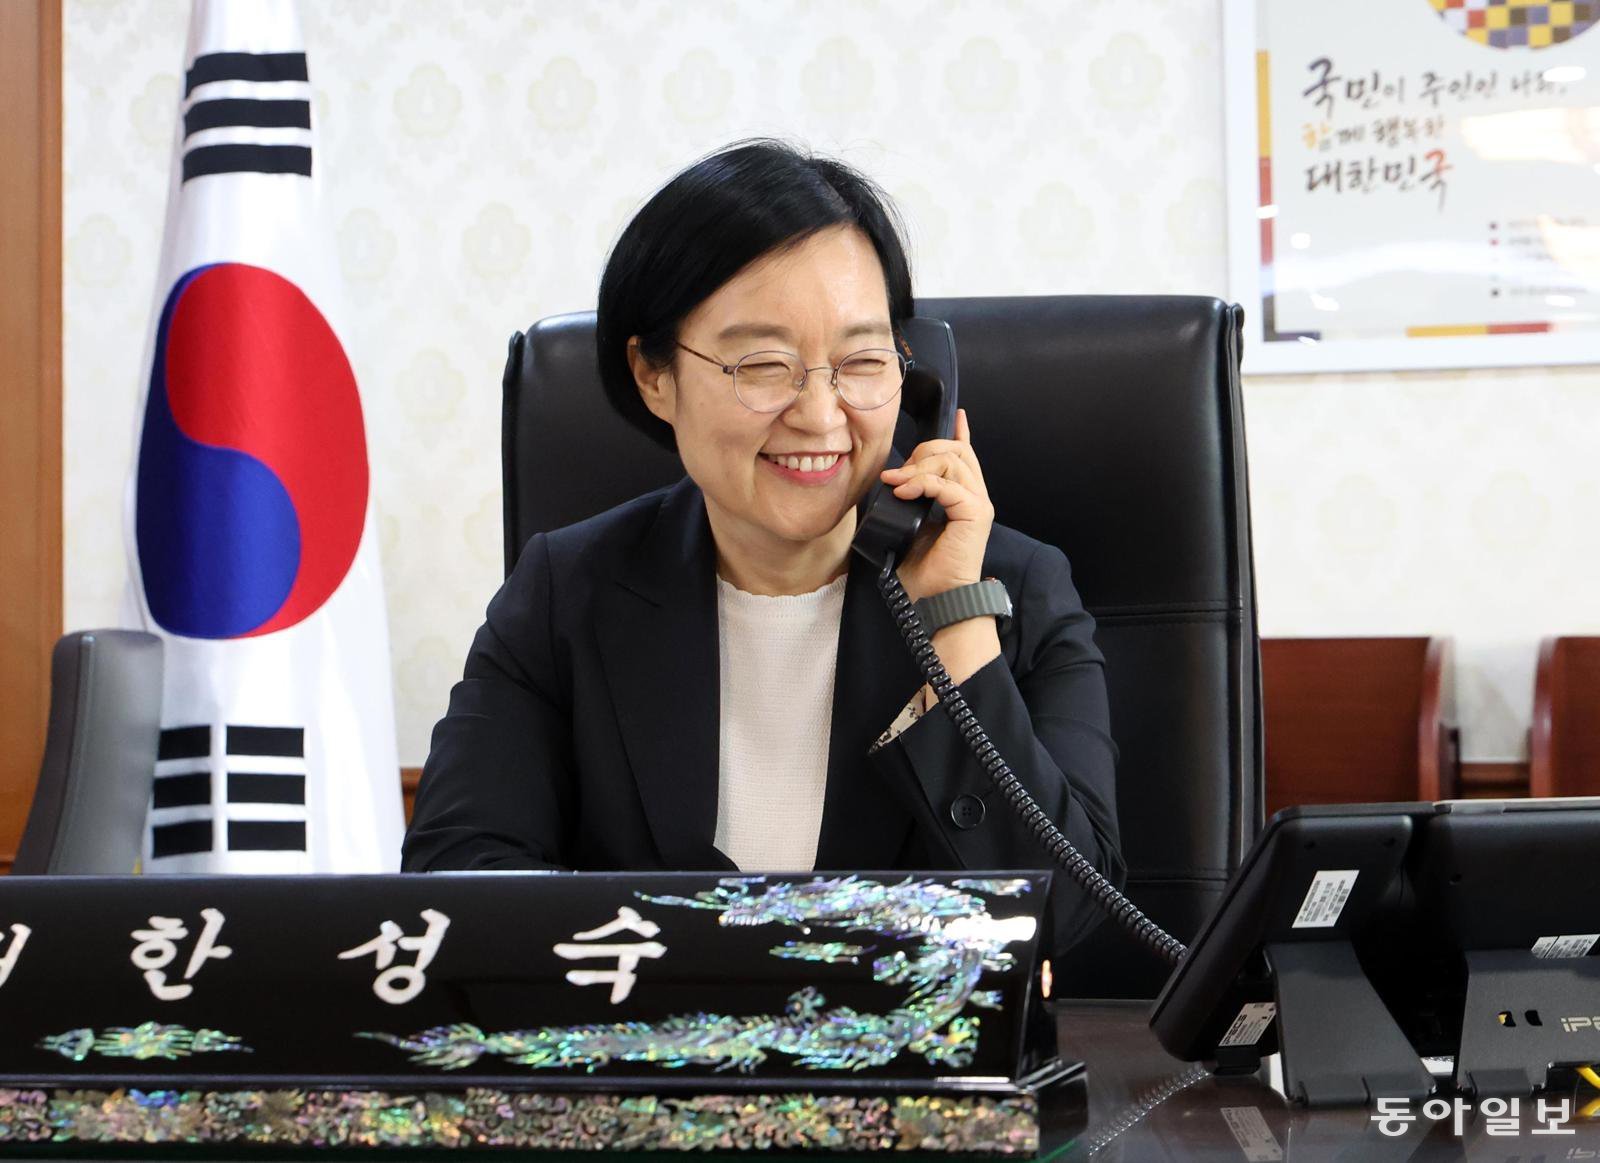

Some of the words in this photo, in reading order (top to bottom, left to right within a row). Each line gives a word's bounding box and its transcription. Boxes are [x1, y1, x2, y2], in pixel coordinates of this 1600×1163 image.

[1303, 57, 1405, 119] 국민이
[1419, 70, 1498, 107] 주인인
[1302, 121, 1366, 150] 함께
[1303, 149, 1453, 213] 대한민국
